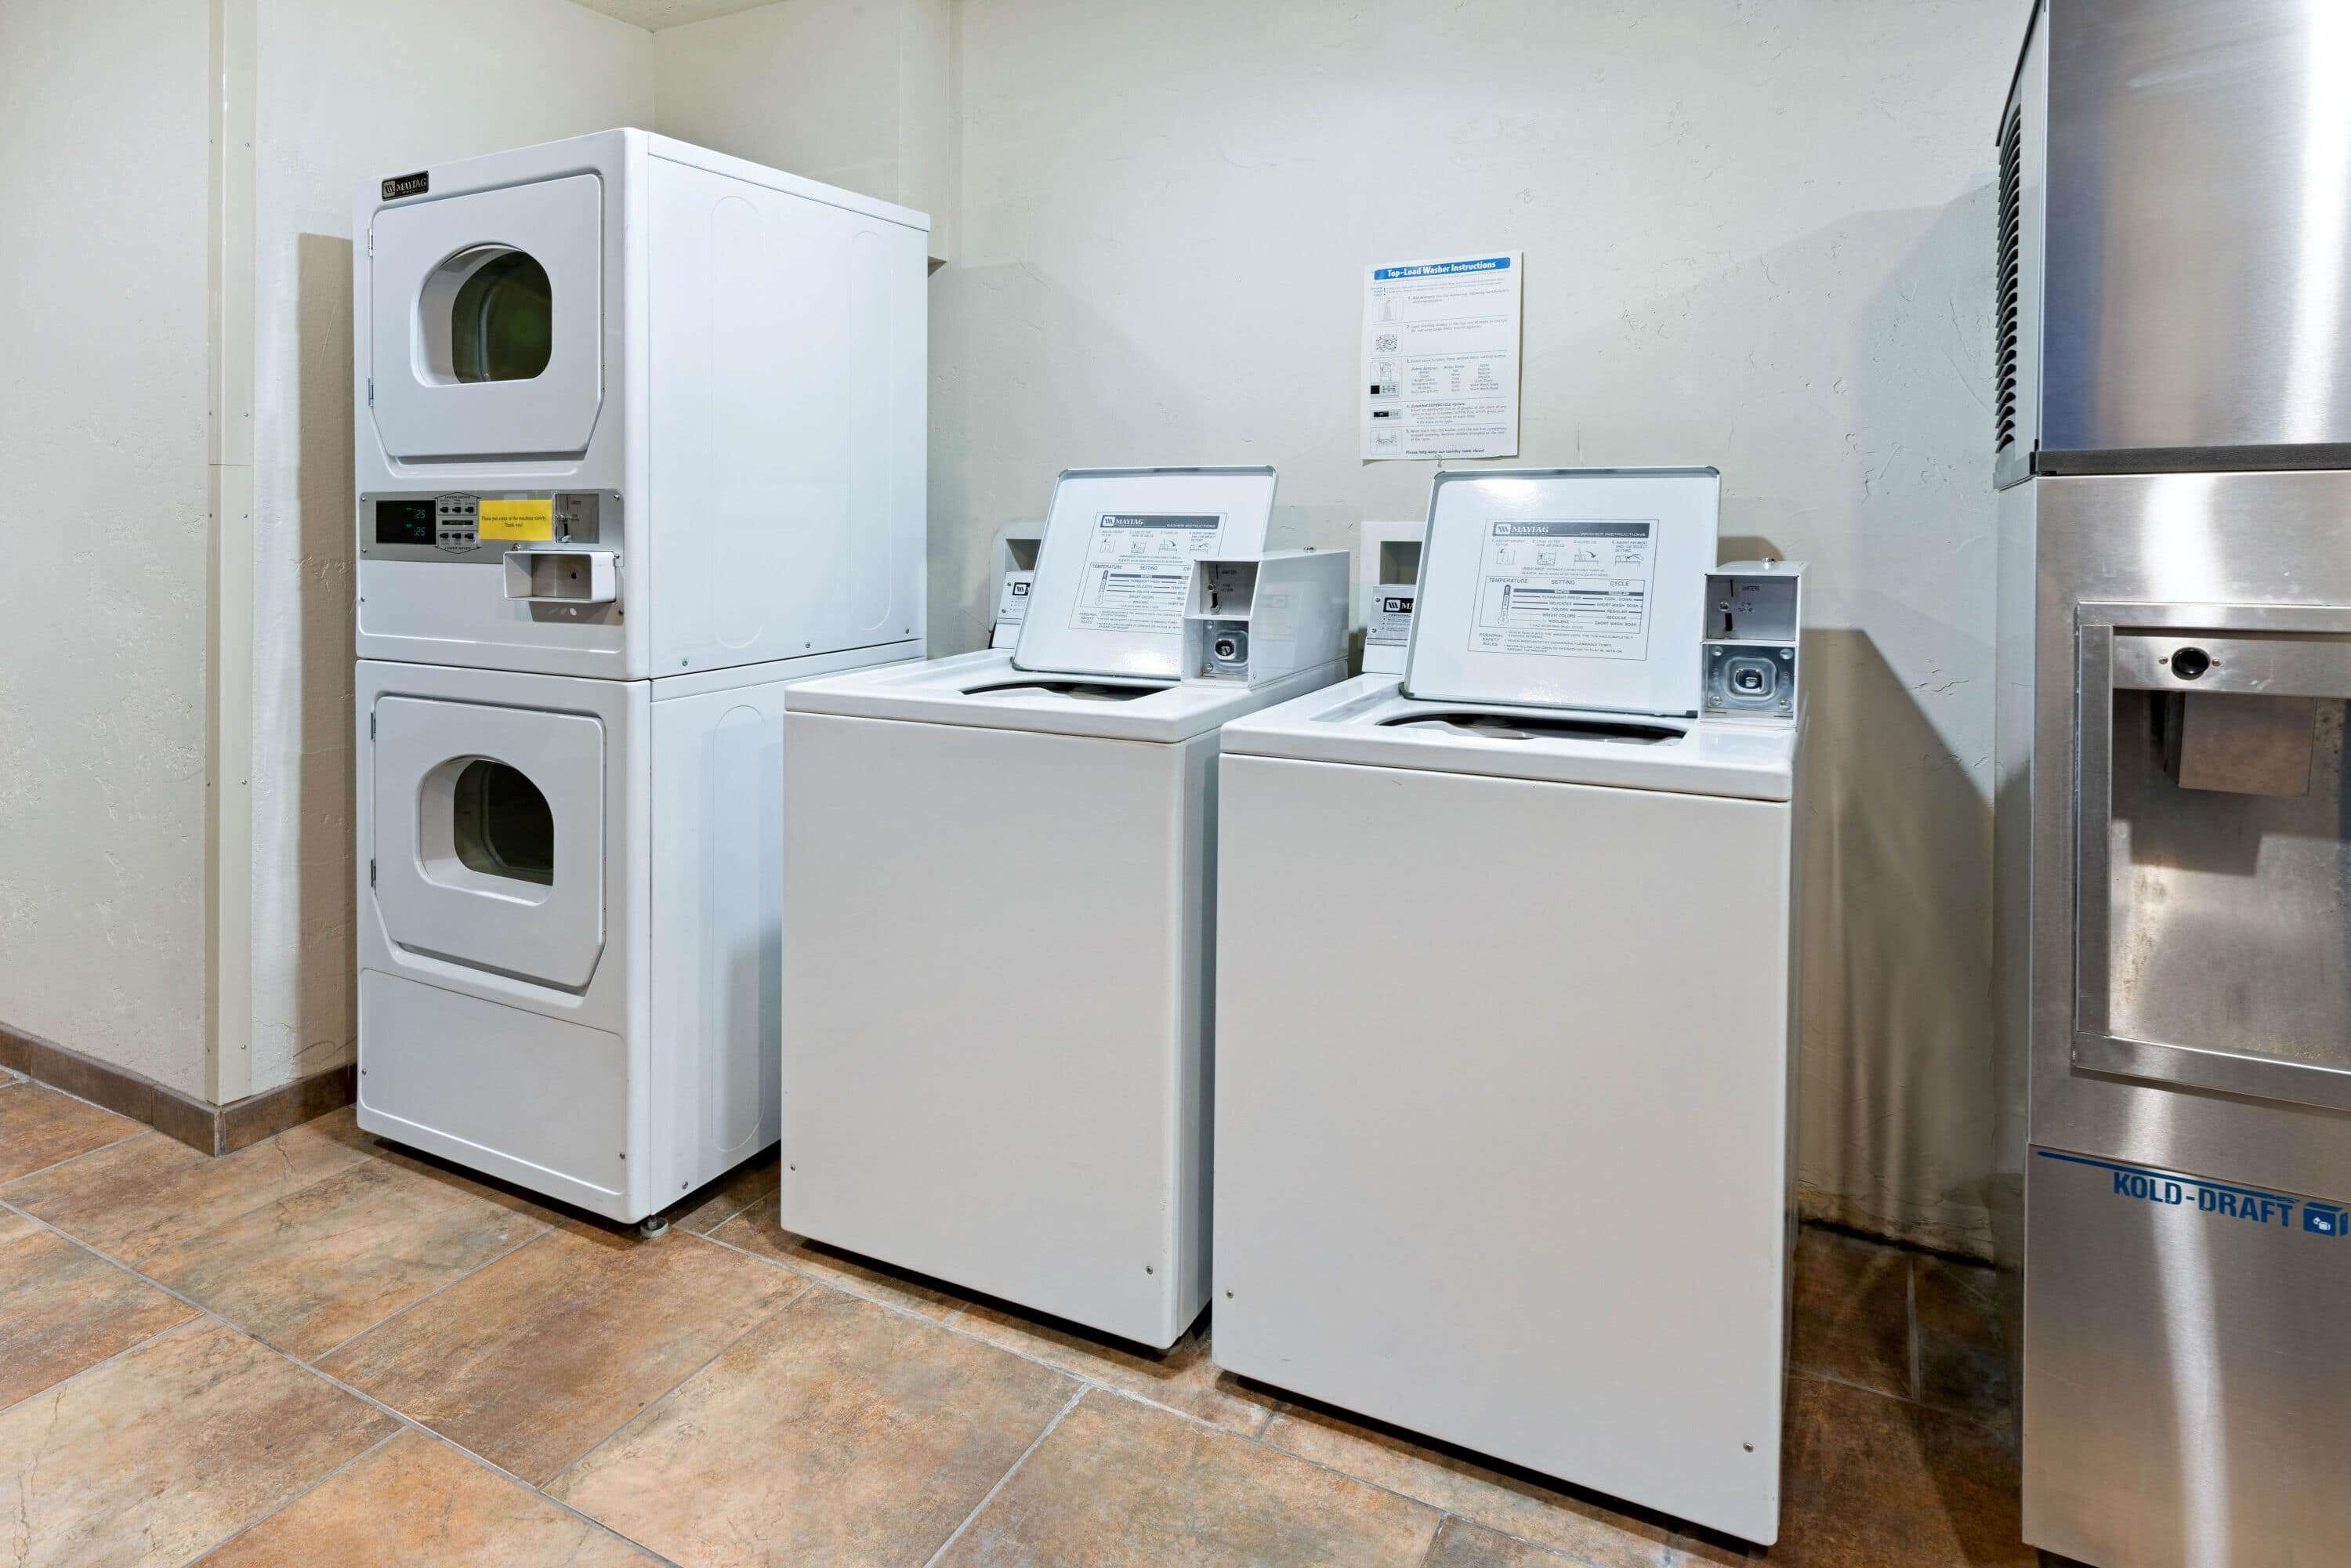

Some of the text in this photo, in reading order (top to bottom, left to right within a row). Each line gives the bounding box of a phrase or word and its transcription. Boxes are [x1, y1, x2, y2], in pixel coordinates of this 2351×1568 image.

[396, 178, 426, 192] MAYTAG
[1388, 261, 1496, 277] Top-Load Washer Instructions
[2114, 1171, 2294, 1228] KOLD-DRAFT
